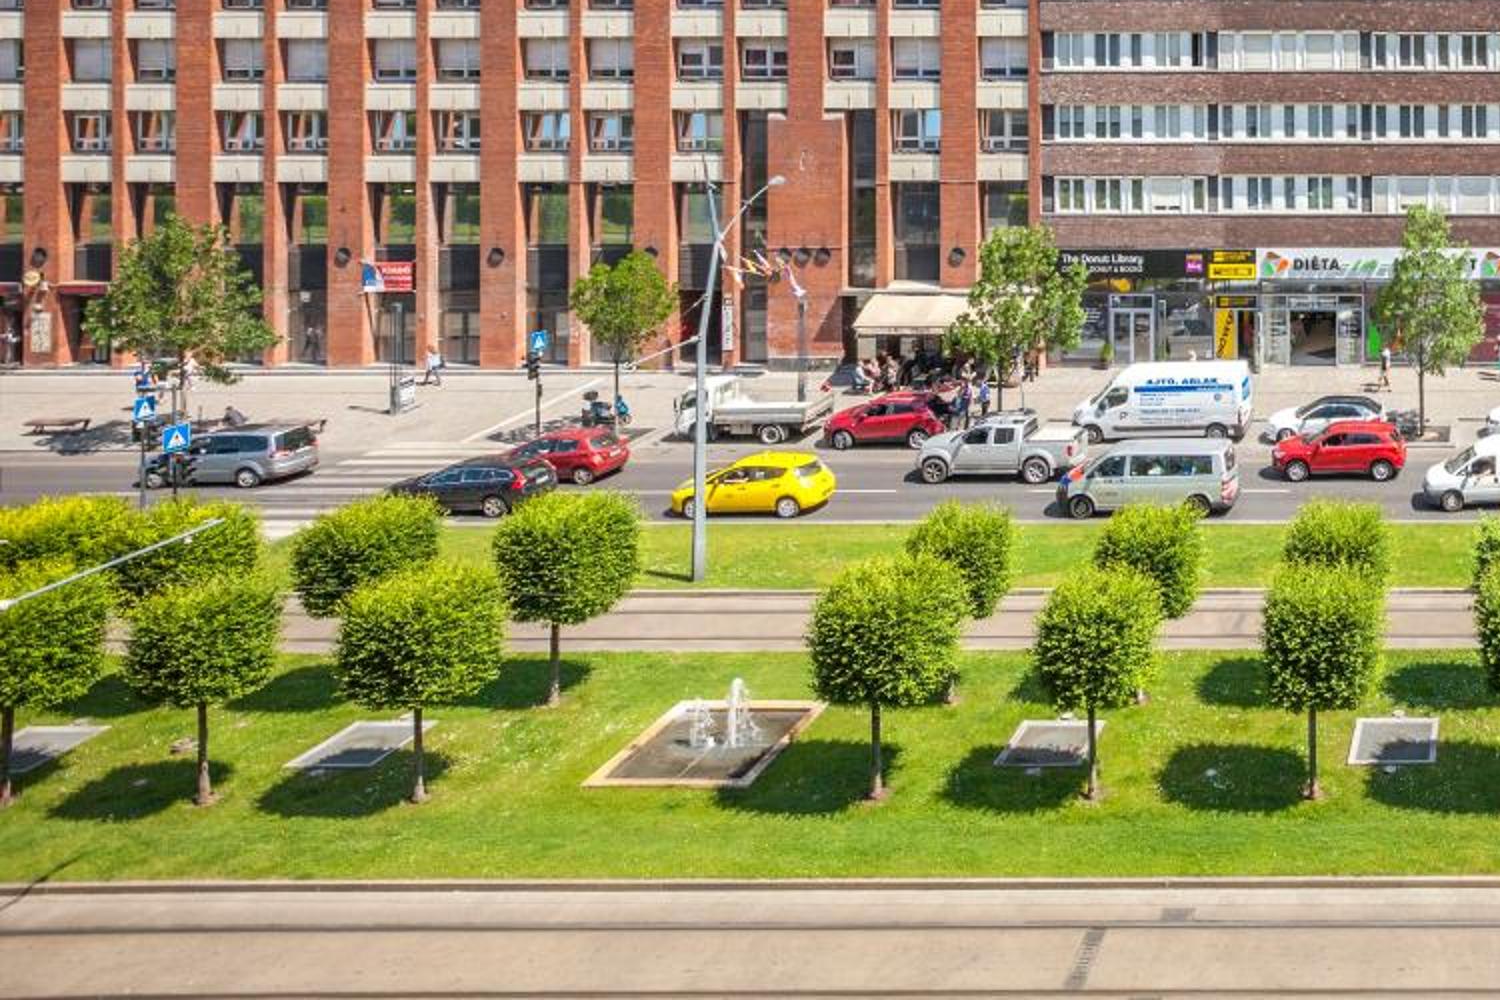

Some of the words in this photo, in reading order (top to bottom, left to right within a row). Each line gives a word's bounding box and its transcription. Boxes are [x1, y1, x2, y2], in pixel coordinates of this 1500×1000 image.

[1062, 254, 1079, 263] The
[1111, 253, 1144, 265] Library
[1293, 254, 1341, 271] DIÉTA
